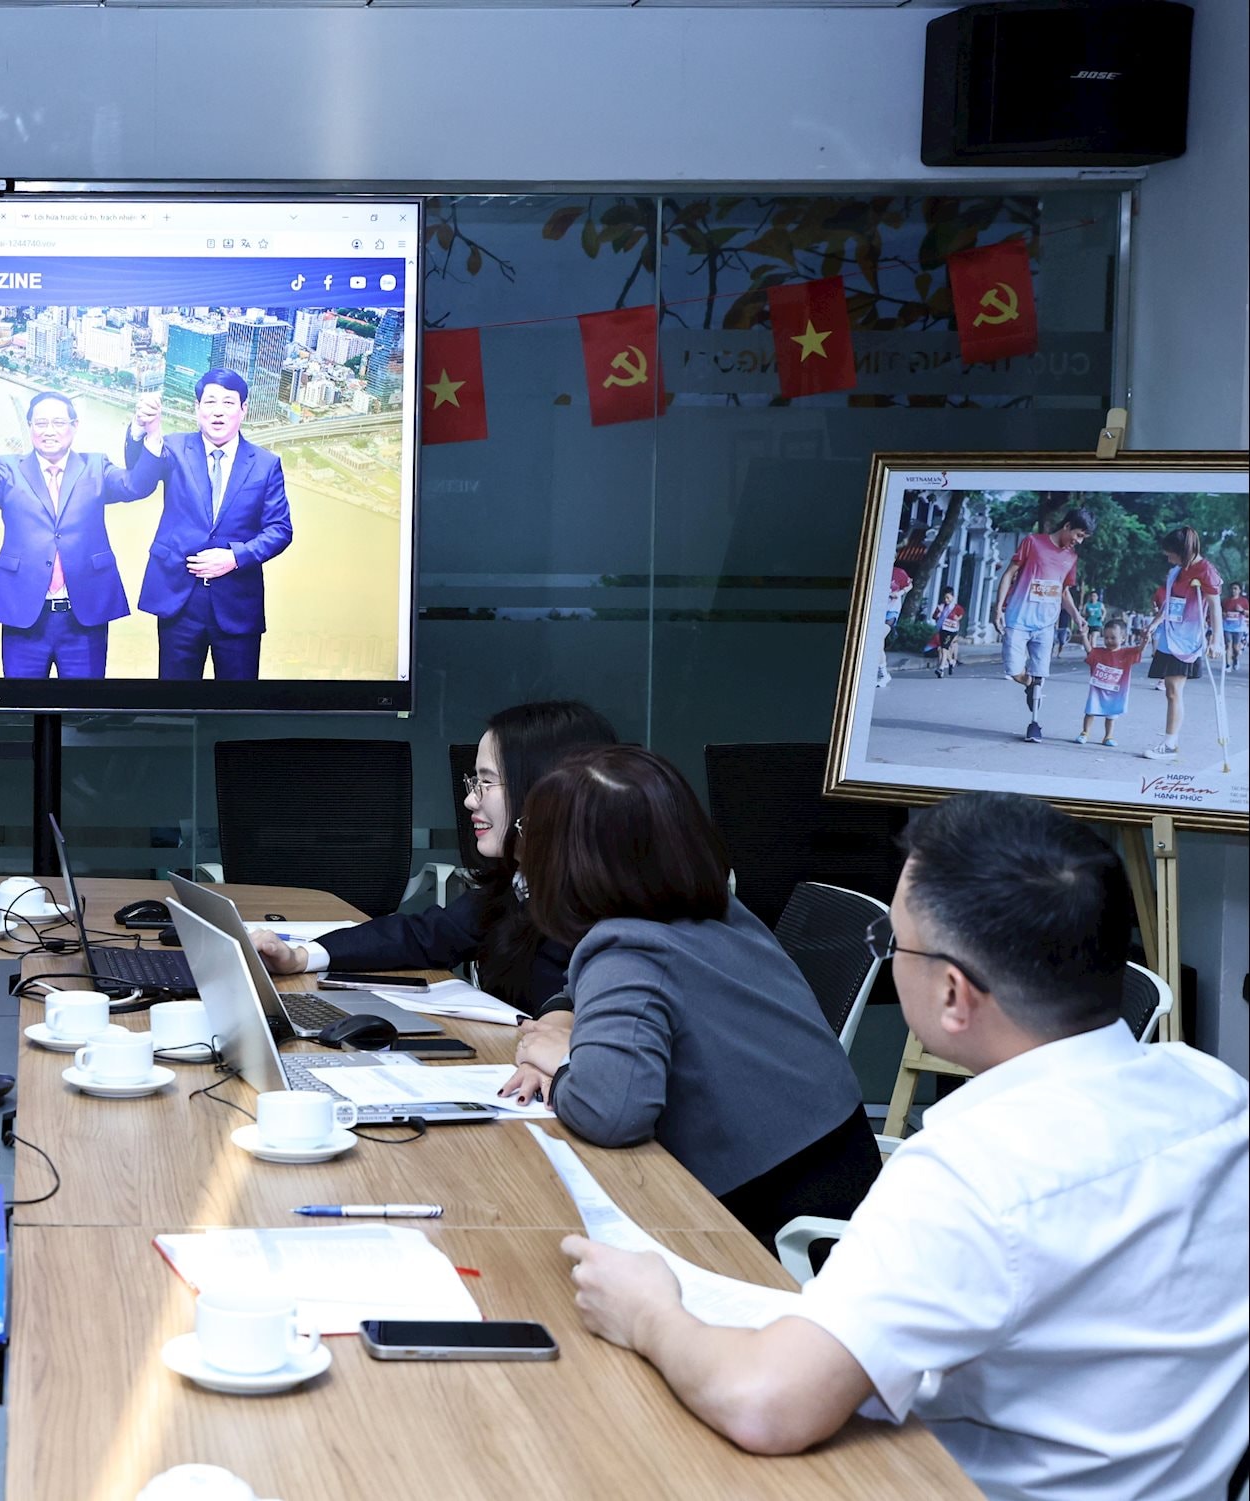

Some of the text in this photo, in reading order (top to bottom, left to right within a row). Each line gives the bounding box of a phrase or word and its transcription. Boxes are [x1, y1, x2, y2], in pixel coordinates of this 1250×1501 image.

[1069, 70, 1123, 81] BOSE
[1166, 773, 1195, 782] HAPPY
[1140, 776, 1220, 795] Vietnam
